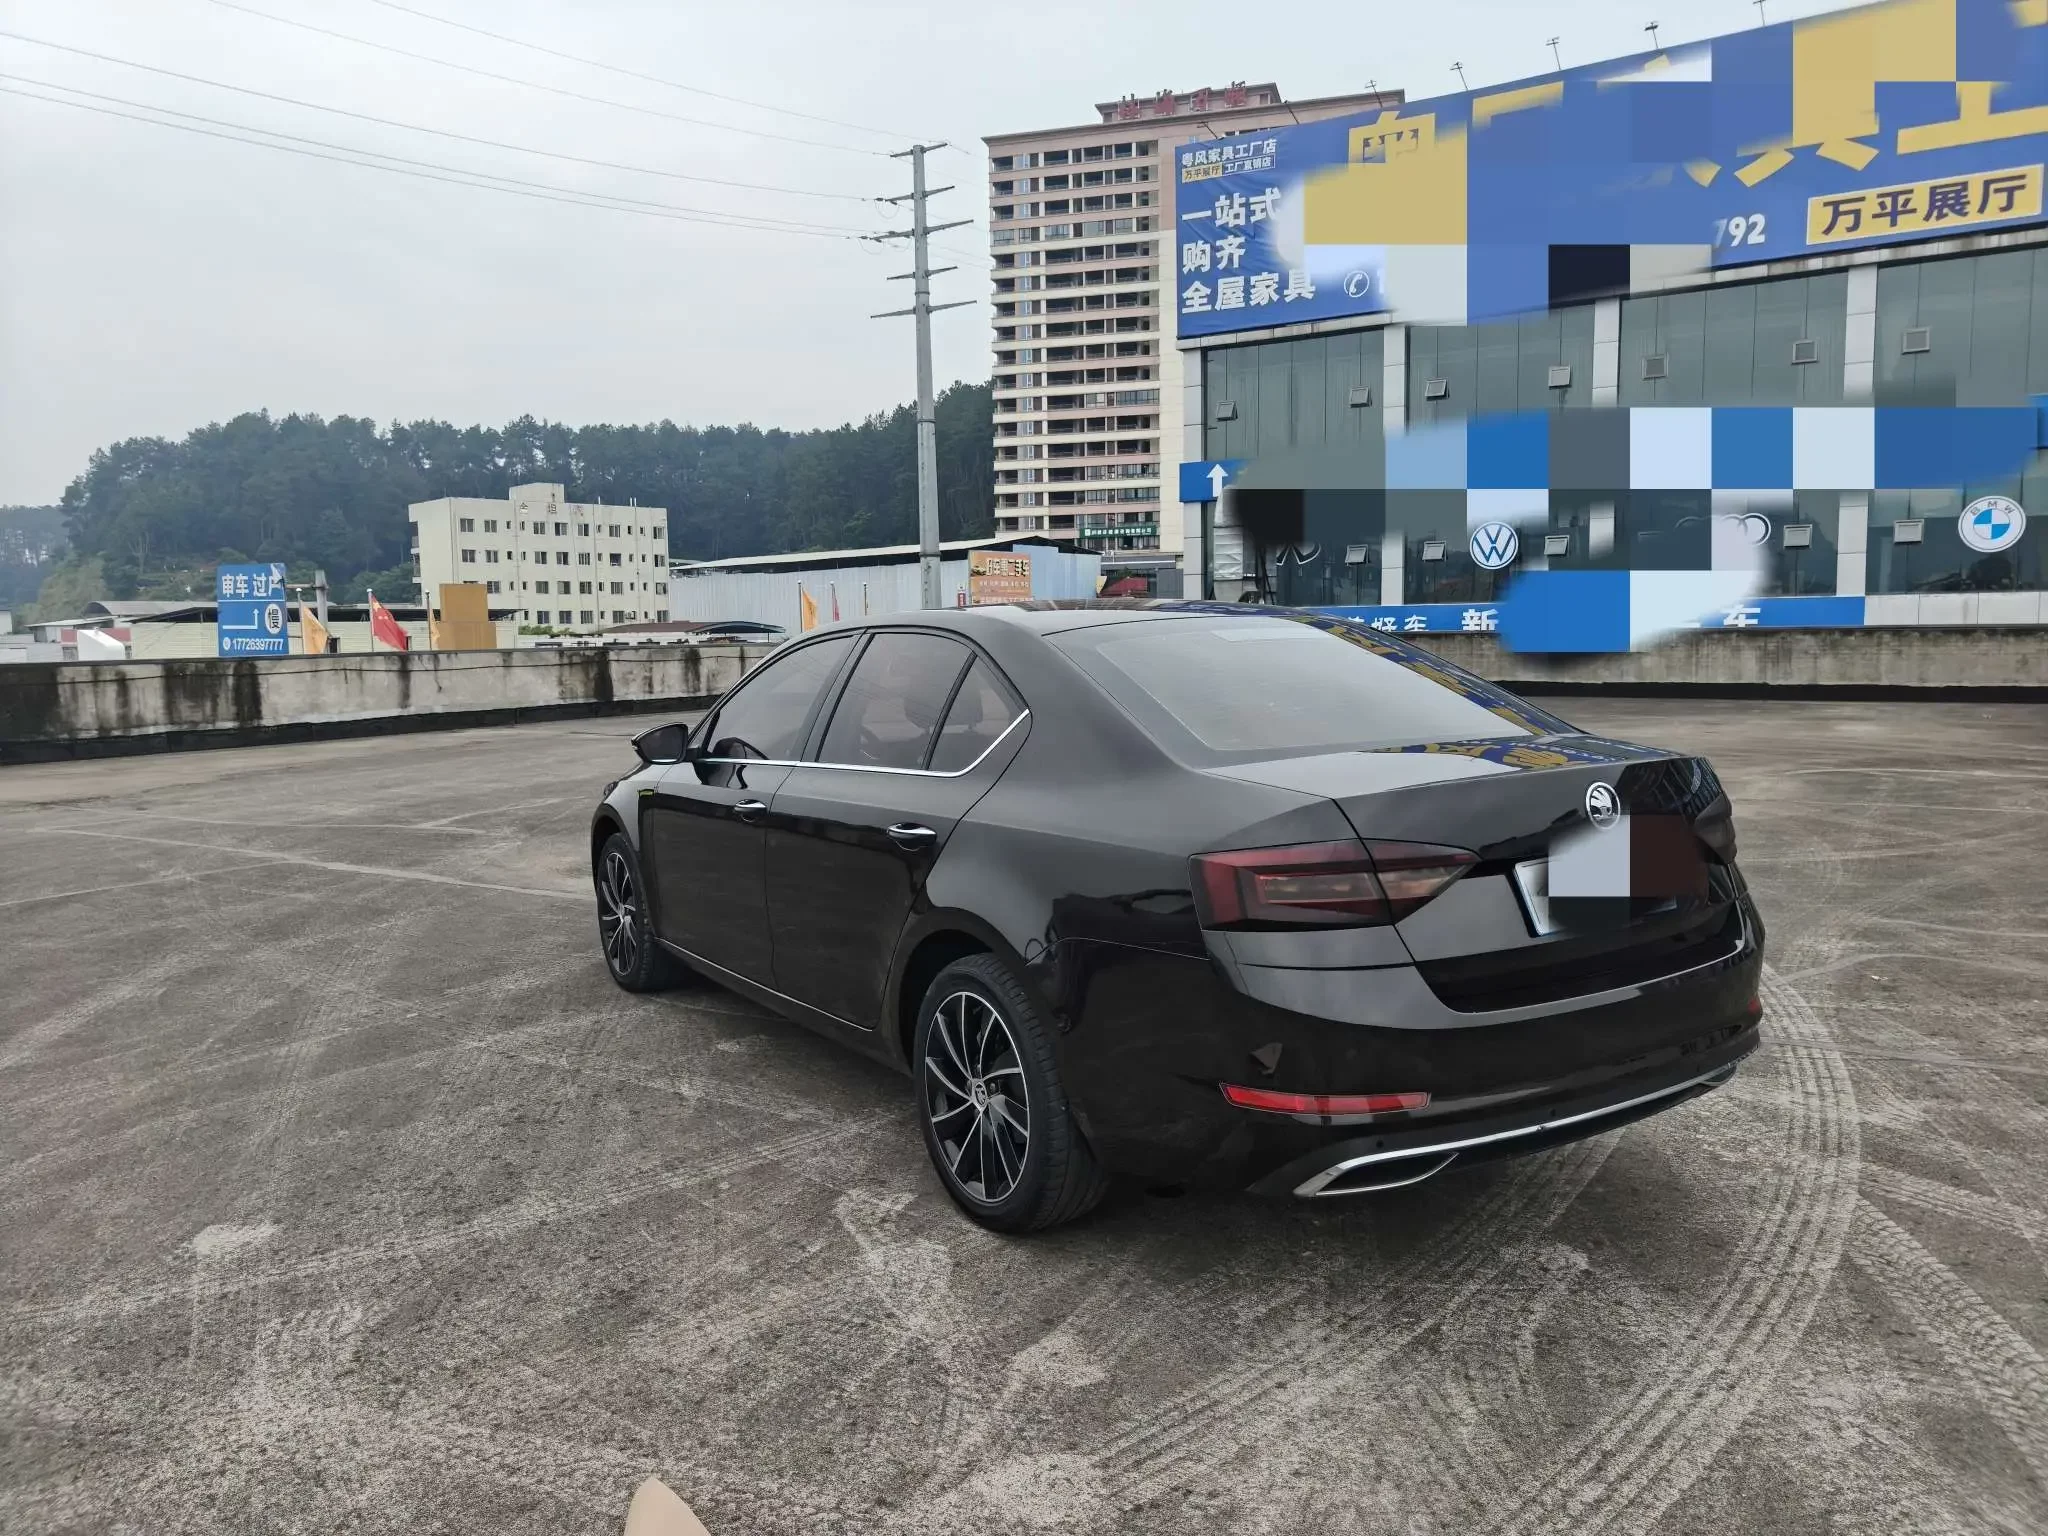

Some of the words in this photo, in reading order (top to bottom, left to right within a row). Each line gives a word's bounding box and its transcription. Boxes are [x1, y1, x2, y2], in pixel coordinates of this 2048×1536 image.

[1181, 138, 1277, 167] 粤风家具工厂店
[1184, 165, 1220, 180] 万平展厅
[1225, 156, 1271, 174] 工厂直销店
[1181, 187, 1281, 228] 一站式
[1821, 173, 2028, 236] 万平展厅
[1182, 235, 1246, 275] 购齐
[1181, 269, 1316, 314] 全屋家具
